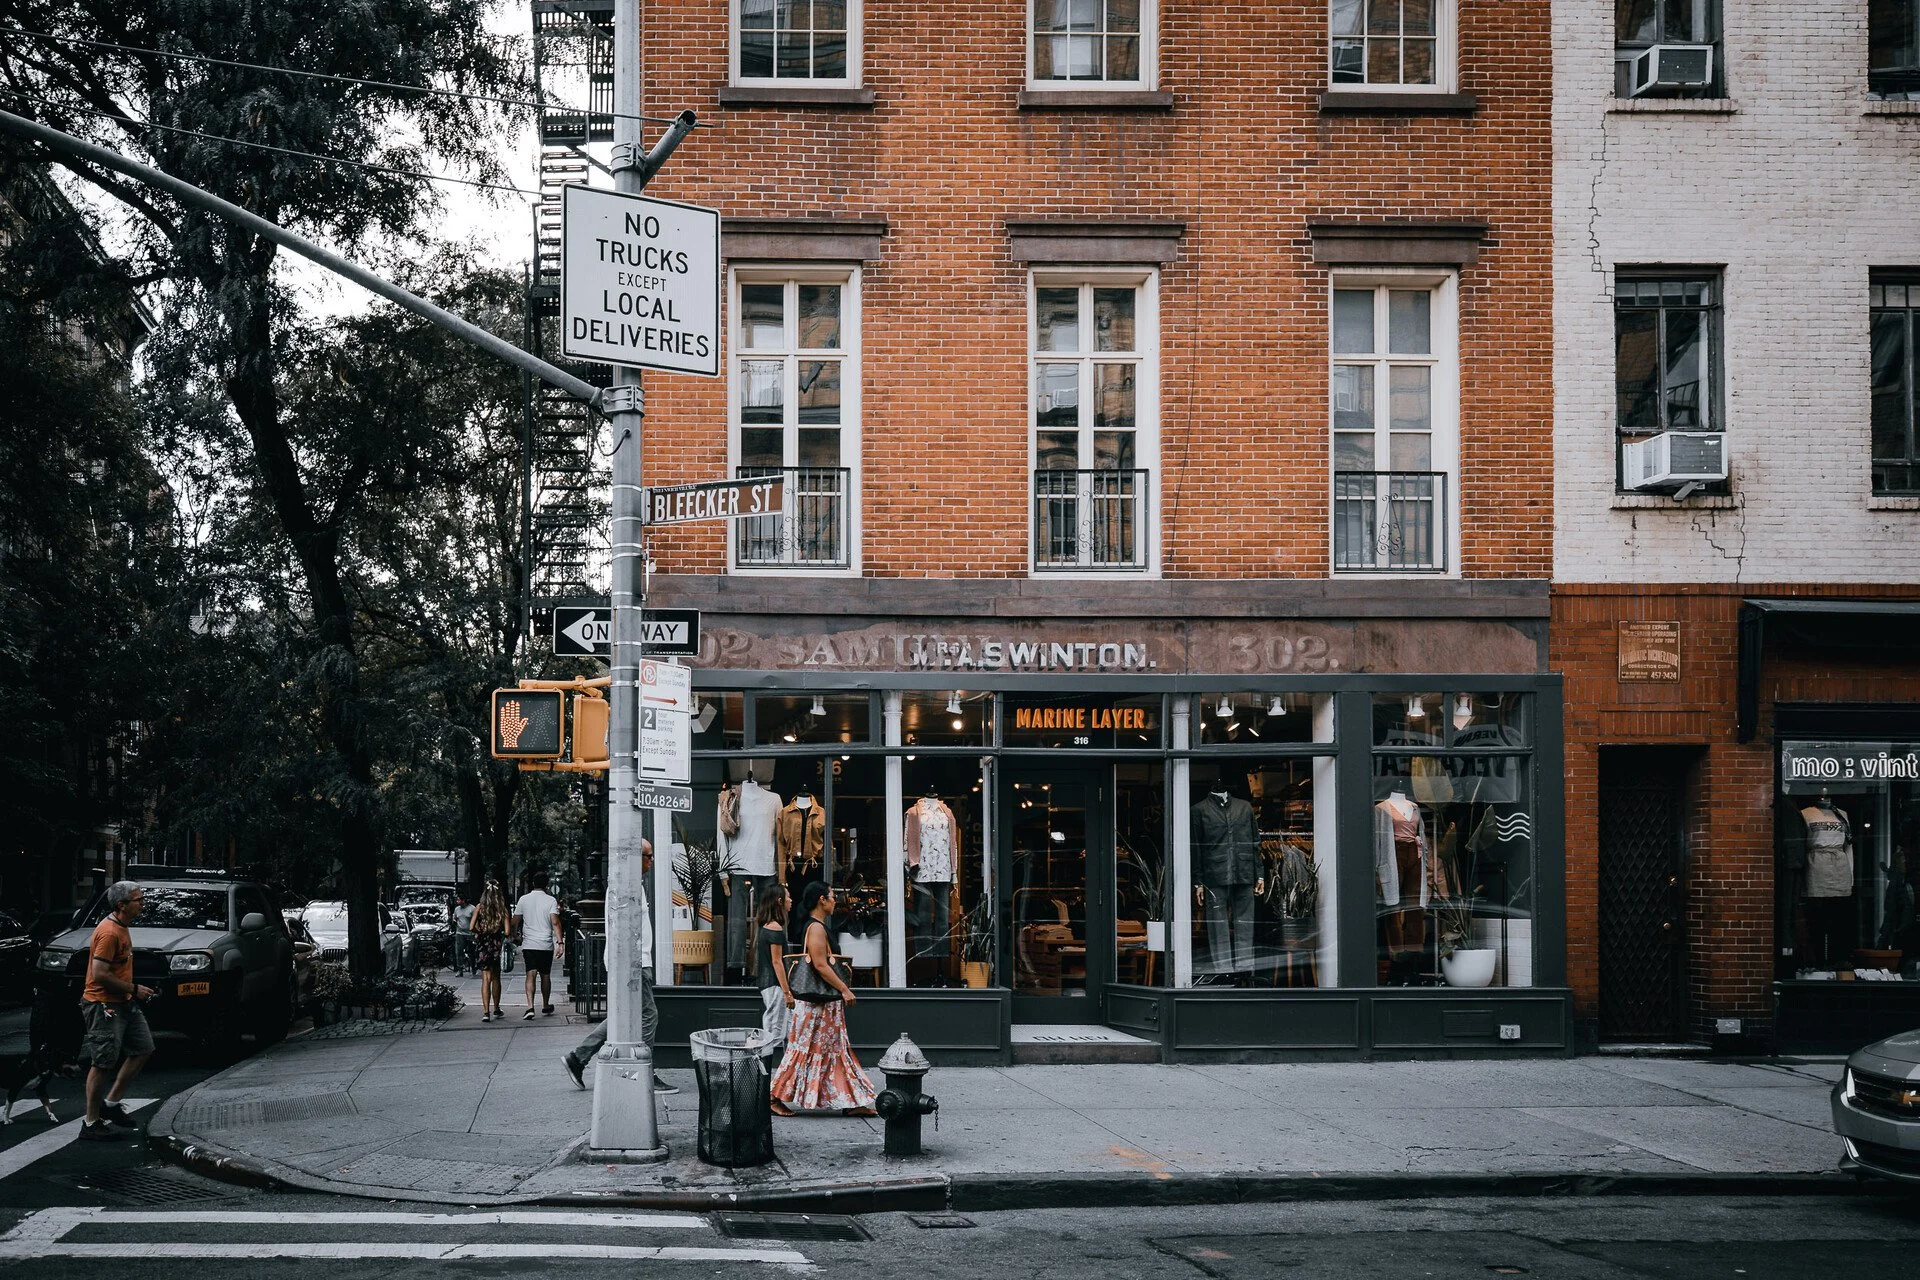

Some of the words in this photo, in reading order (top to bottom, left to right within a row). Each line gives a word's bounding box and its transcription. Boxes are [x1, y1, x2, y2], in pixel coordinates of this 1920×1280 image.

[625, 211, 660, 239] NO
[596, 238, 689, 274] TRUCKS
[618, 272, 667, 292] EXCEPT
[604, 289, 681, 323] LOCAL
[573, 316, 709, 358] DELIVERIES
[654, 487, 740, 522] BLEECKER
[750, 484, 773, 514] ST
[581, 623, 610, 641] ON
[1650, 671, 1677, 680] 457-2424
[643, 709, 653, 728] 2
[1016, 708, 1086, 728] MARINE
[1091, 708, 1145, 728] LAYER
[1074, 737, 1089, 745] 316
[816, 760, 842, 775] 36
[640, 793, 679, 808] 104826
